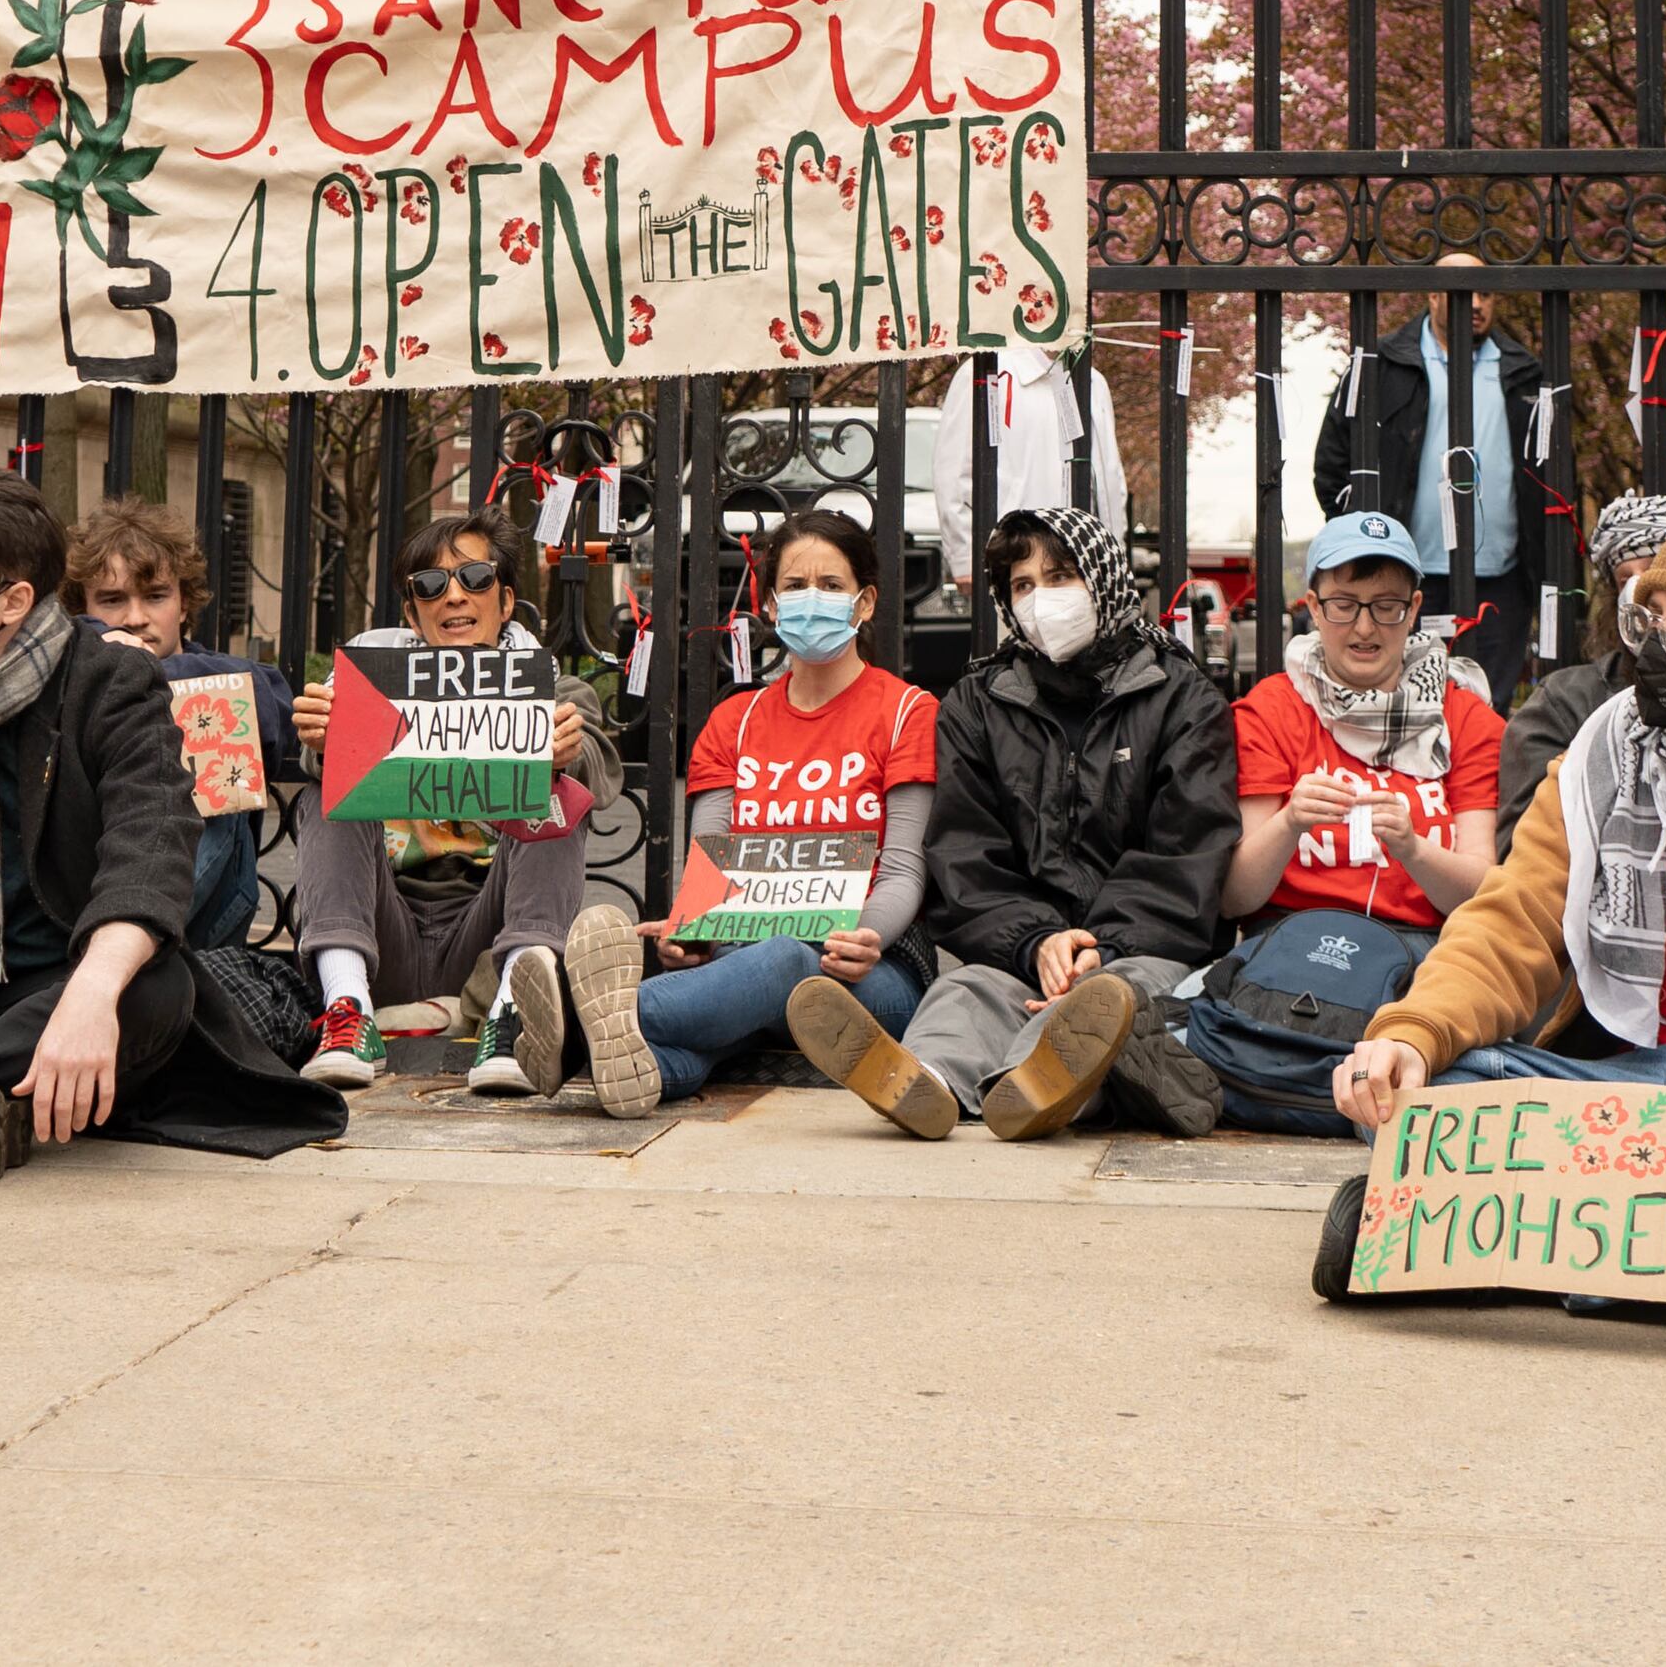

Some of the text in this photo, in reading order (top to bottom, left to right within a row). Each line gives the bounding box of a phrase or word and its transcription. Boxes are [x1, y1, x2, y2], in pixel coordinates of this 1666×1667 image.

[654, 211, 751, 279] THE
[783, 111, 1071, 356] GATES
[171, 674, 244, 697] HMOUD
[408, 650, 535, 697] FREE
[391, 704, 549, 754] MAHMOUD
[408, 762, 545, 814] KHALIL
[737, 752, 865, 791] STOP
[731, 792, 881, 826] RMING
[737, 838, 845, 870] FREE
[723, 877, 846, 905] MOHSEN
[695, 914, 834, 938] MAHMOUD
[1394, 1102, 1549, 1181] FREE
